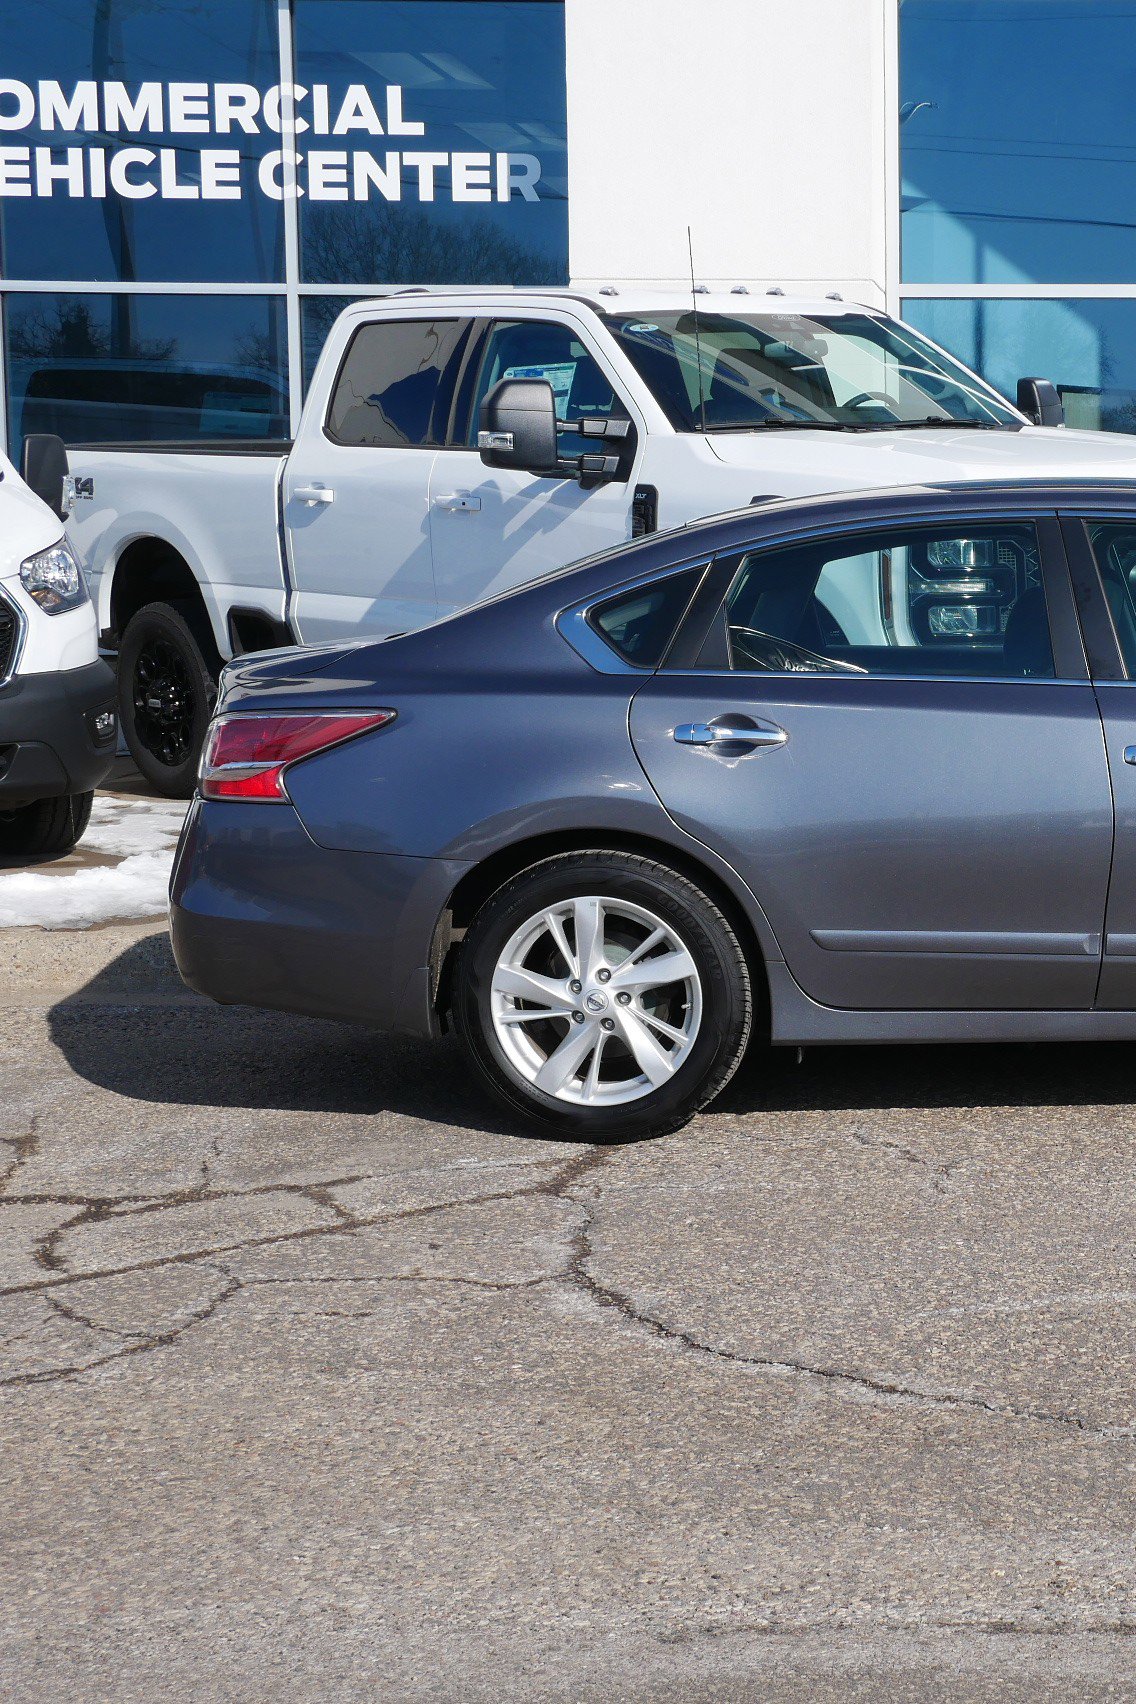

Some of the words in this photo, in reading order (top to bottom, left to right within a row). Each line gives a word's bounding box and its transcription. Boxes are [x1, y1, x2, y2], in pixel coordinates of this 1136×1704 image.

[0, 79, 425, 136] OMMERCIAL
[0, 146, 242, 200] EHICLE
[258, 149, 542, 202] CENTER
